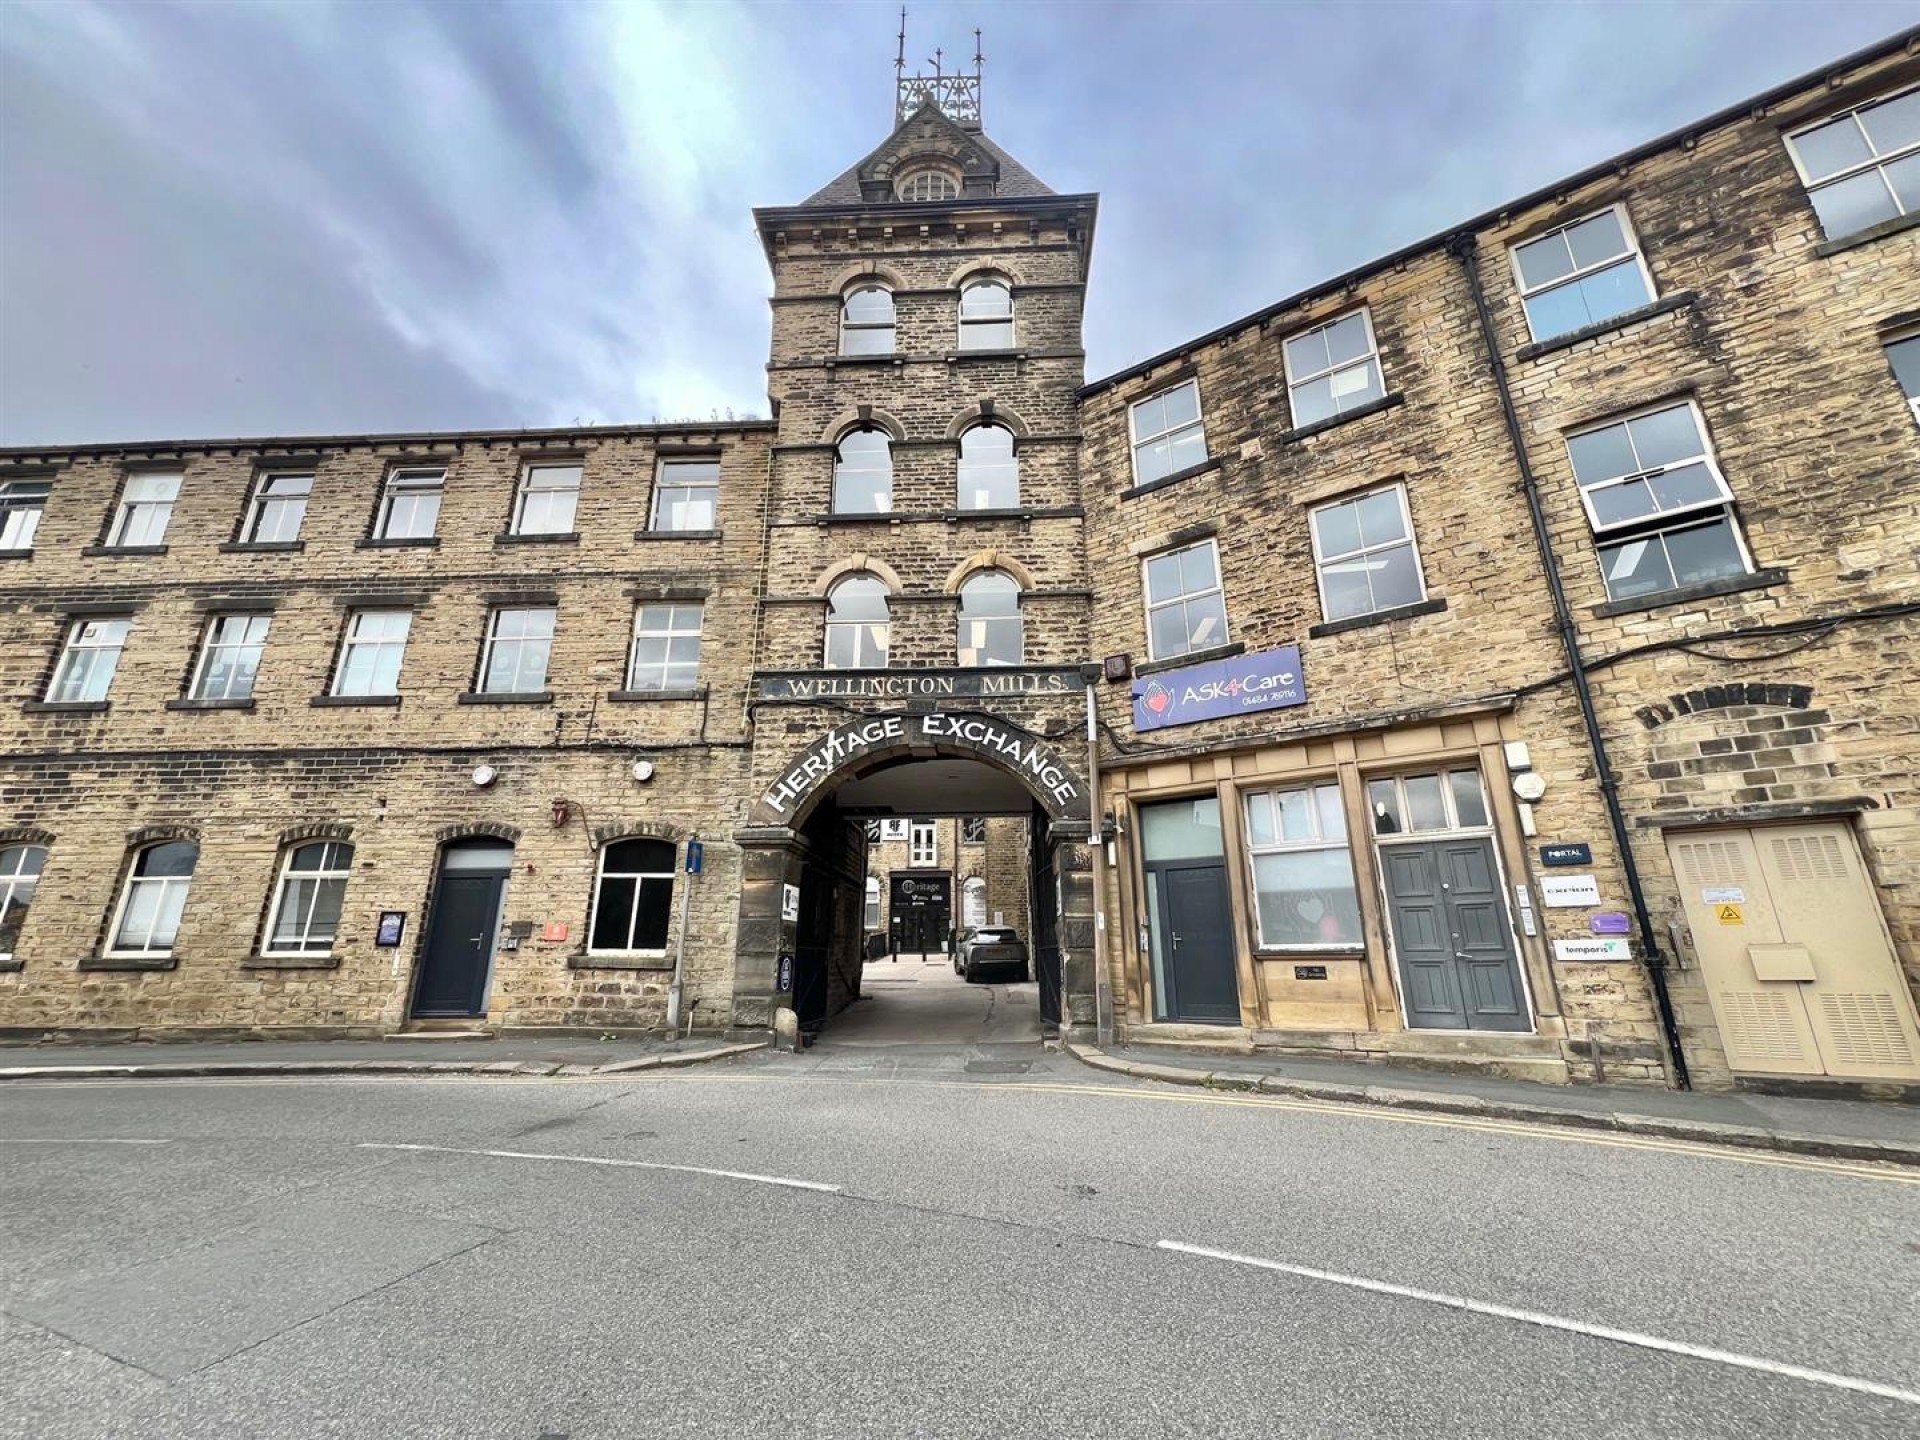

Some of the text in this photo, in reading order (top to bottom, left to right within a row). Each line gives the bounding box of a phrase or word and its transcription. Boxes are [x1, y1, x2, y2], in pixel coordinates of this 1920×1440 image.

[787, 676, 954, 696] WELLINGTON
[766, 713, 1078, 813] HERITAGE EXCHANGE
